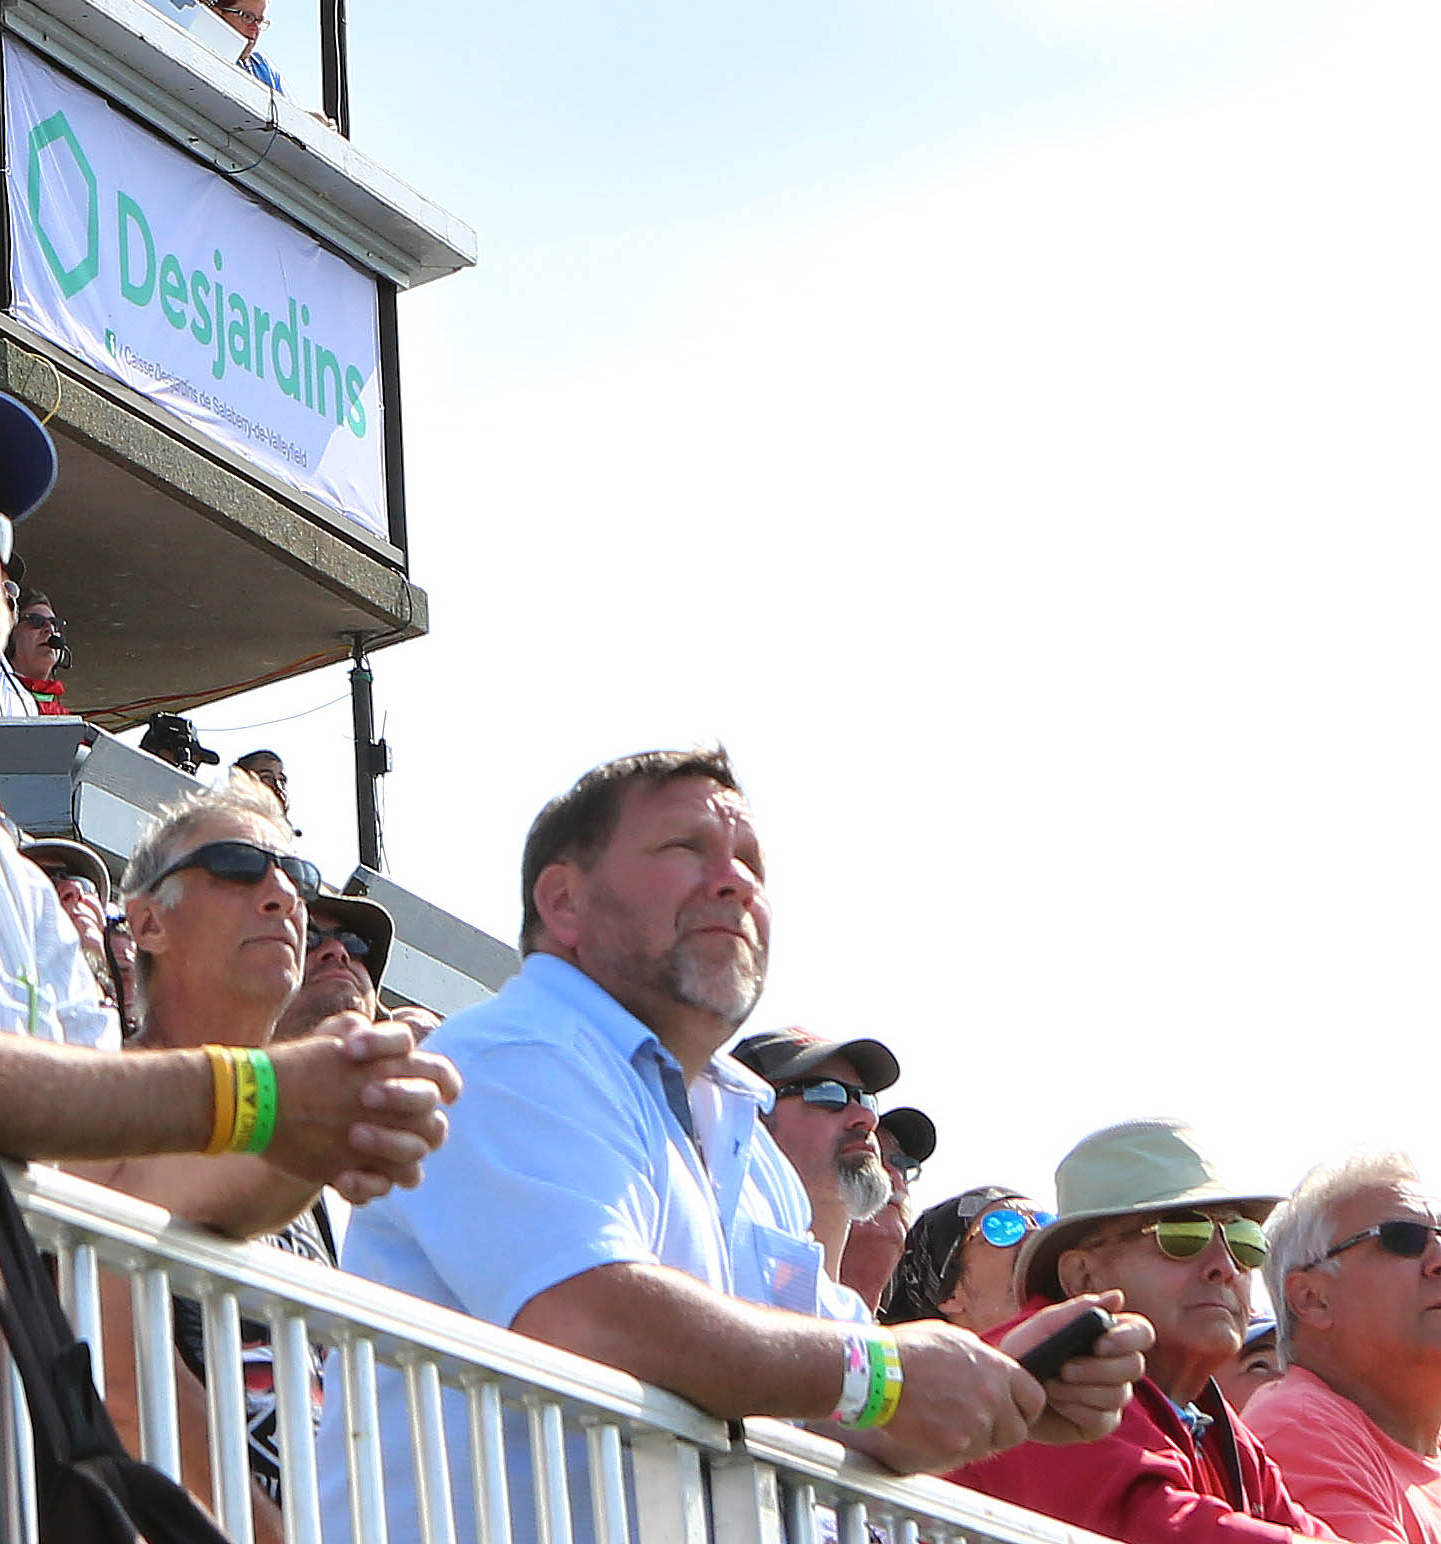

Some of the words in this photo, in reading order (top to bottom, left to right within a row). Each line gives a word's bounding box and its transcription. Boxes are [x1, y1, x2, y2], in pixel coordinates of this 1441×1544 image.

[117, 190, 367, 439] Desjardins
[124, 345, 154, 378] Caisse
[199, 391, 212, 411] de
